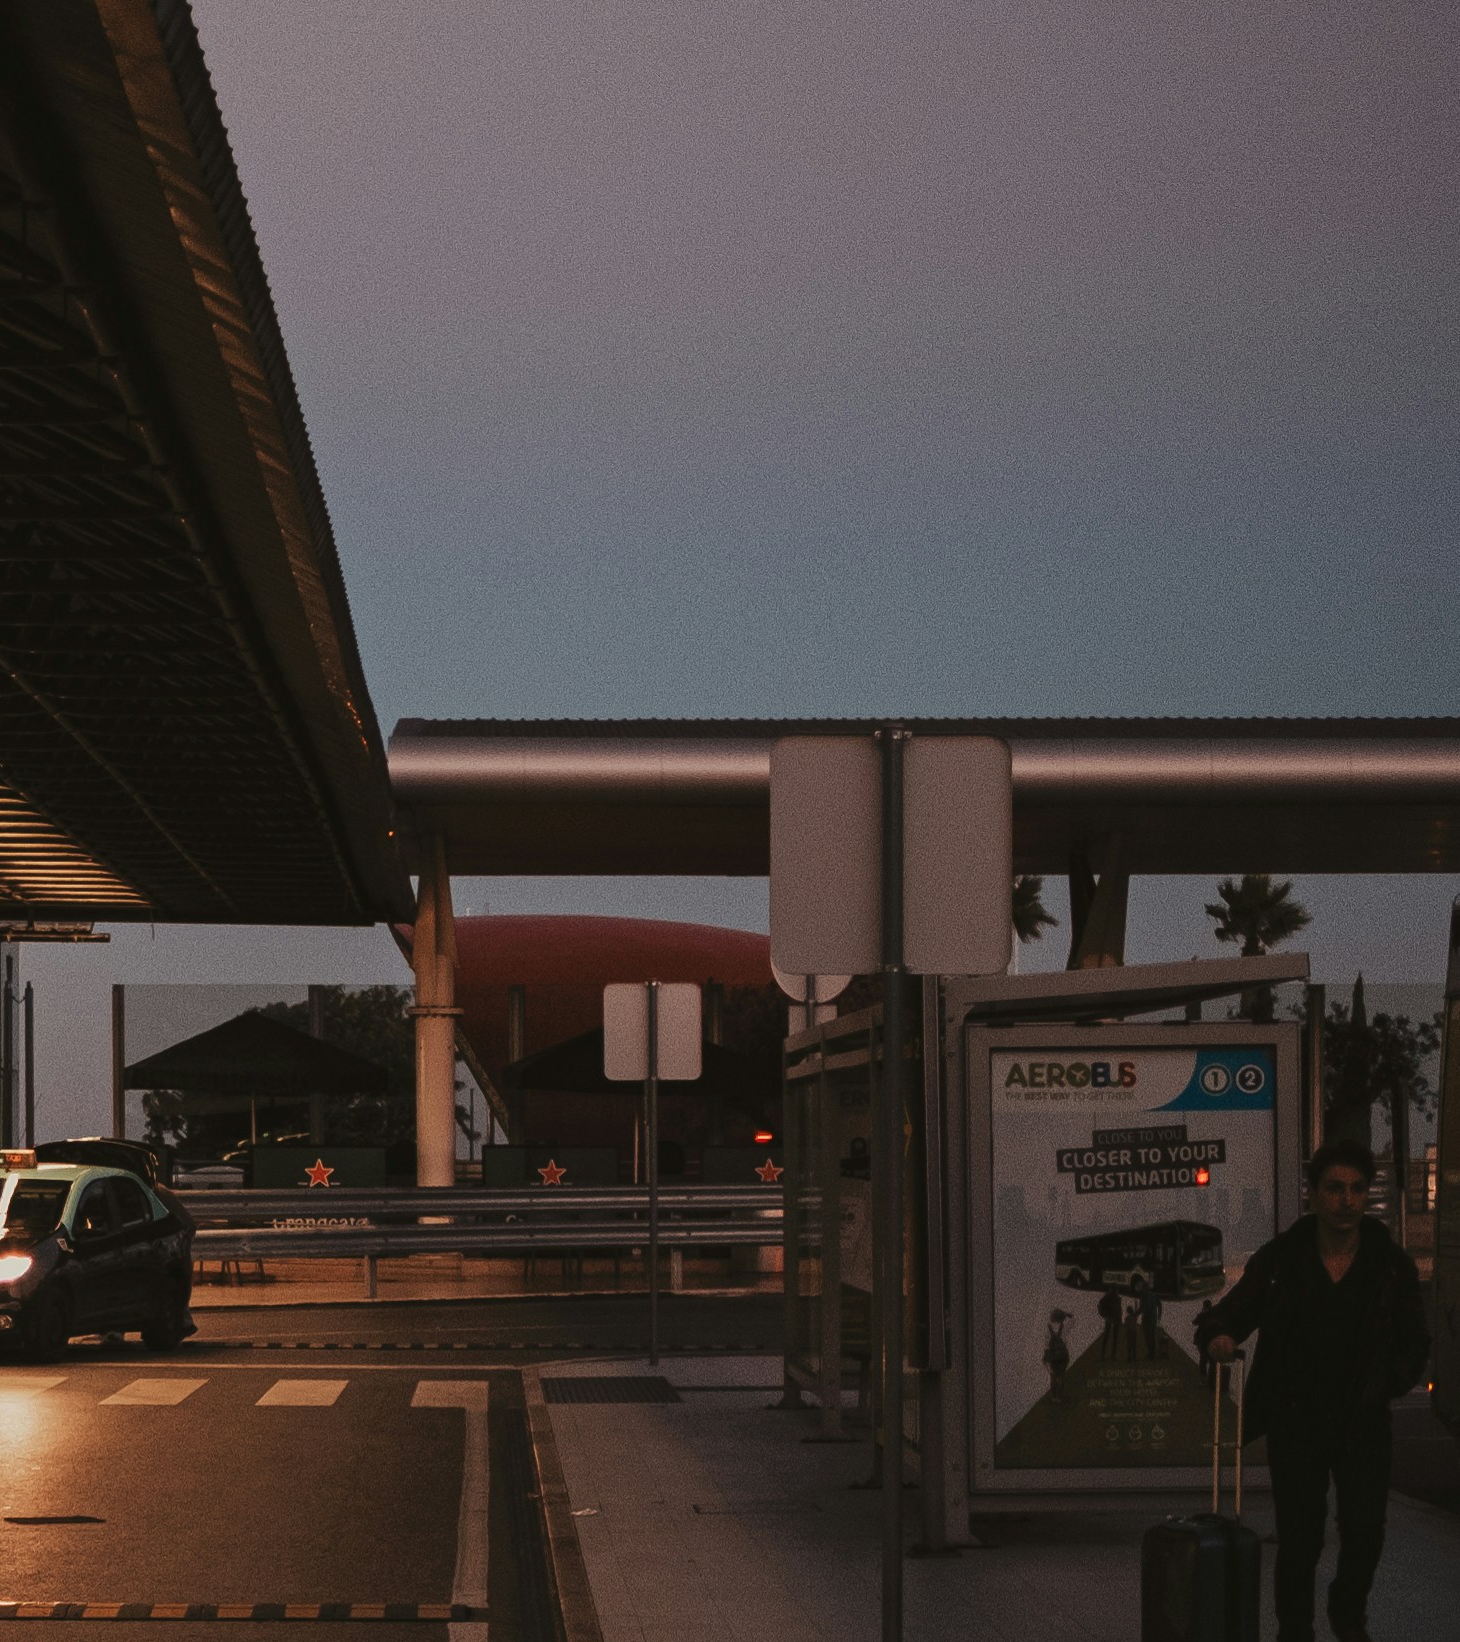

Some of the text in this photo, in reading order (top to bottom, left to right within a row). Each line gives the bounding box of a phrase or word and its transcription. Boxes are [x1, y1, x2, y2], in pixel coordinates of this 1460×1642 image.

[1004, 1061, 1137, 1088] AEROBUS
[1096, 1128, 1183, 1147] CLOSE TO YOU
[1061, 1144, 1220, 1169] CLOSER TO YOUR
